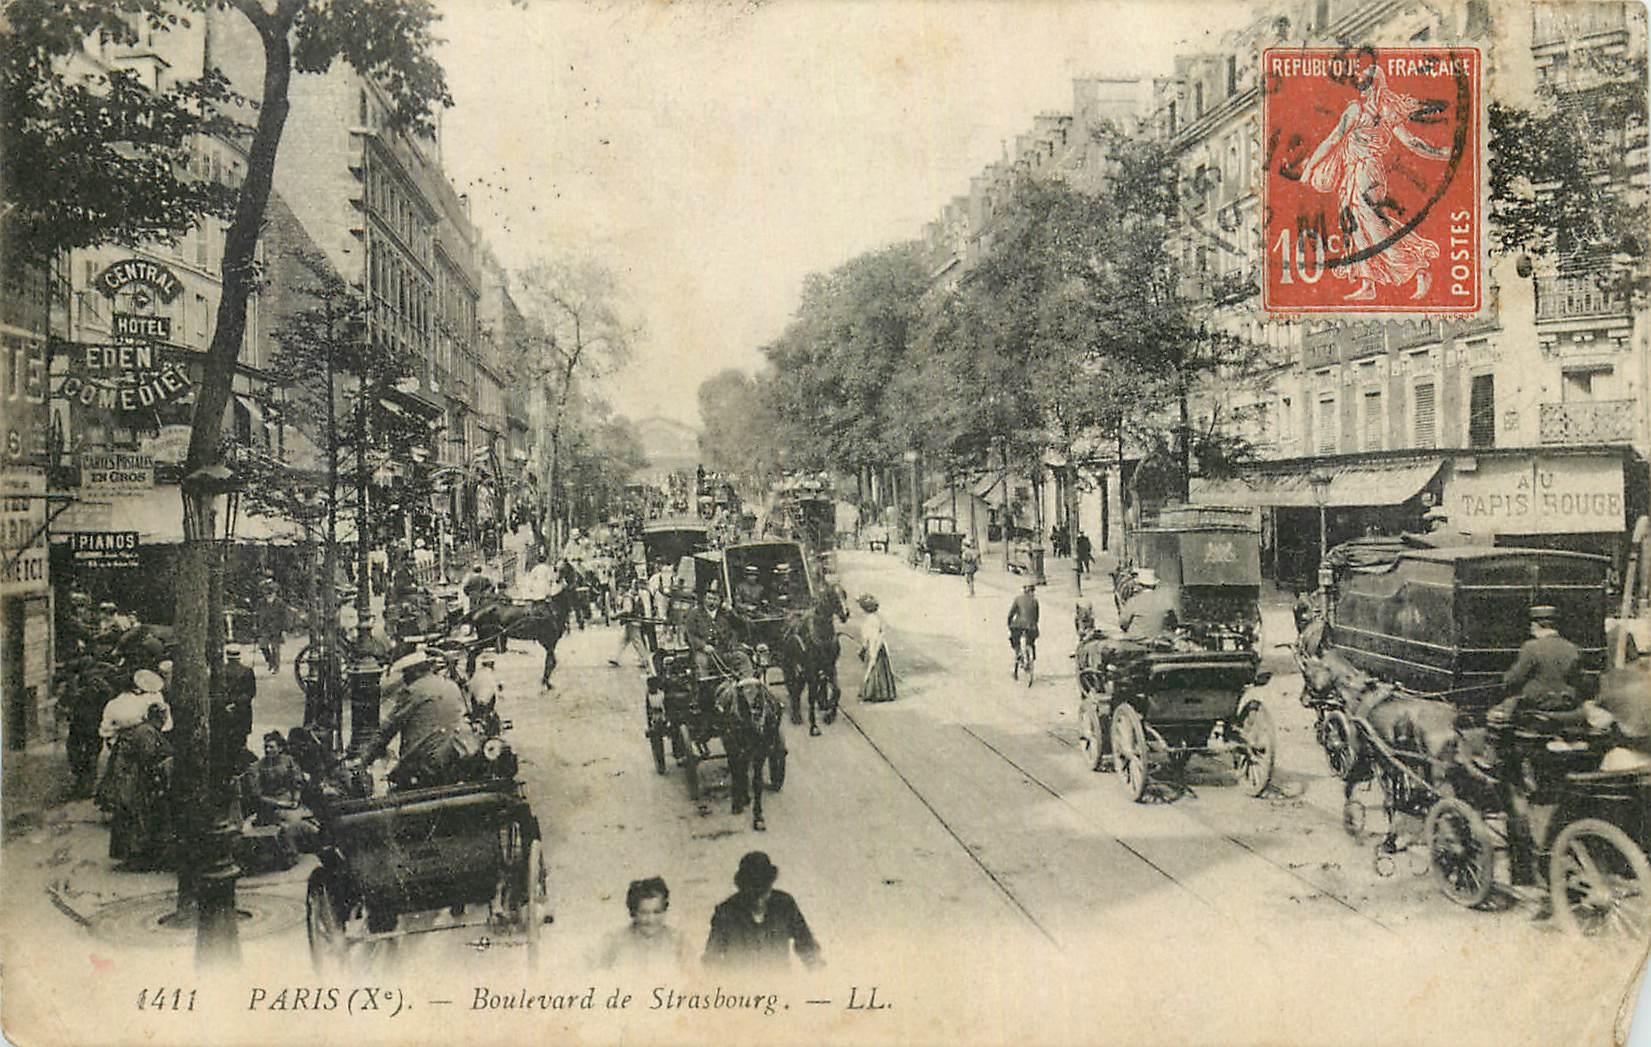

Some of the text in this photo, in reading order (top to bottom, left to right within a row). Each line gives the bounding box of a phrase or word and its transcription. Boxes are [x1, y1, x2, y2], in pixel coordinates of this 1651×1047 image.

[1451, 209, 1470, 296] POSTES
[105, 261, 174, 295] CENTRAL
[117, 318, 166, 336] HOTEL
[87, 347, 151, 369] EDEN
[109, 471, 146, 483] GROS
[1461, 493, 1621, 517] TAPIS ROUGE
[79, 534, 135, 550] PIANOS
